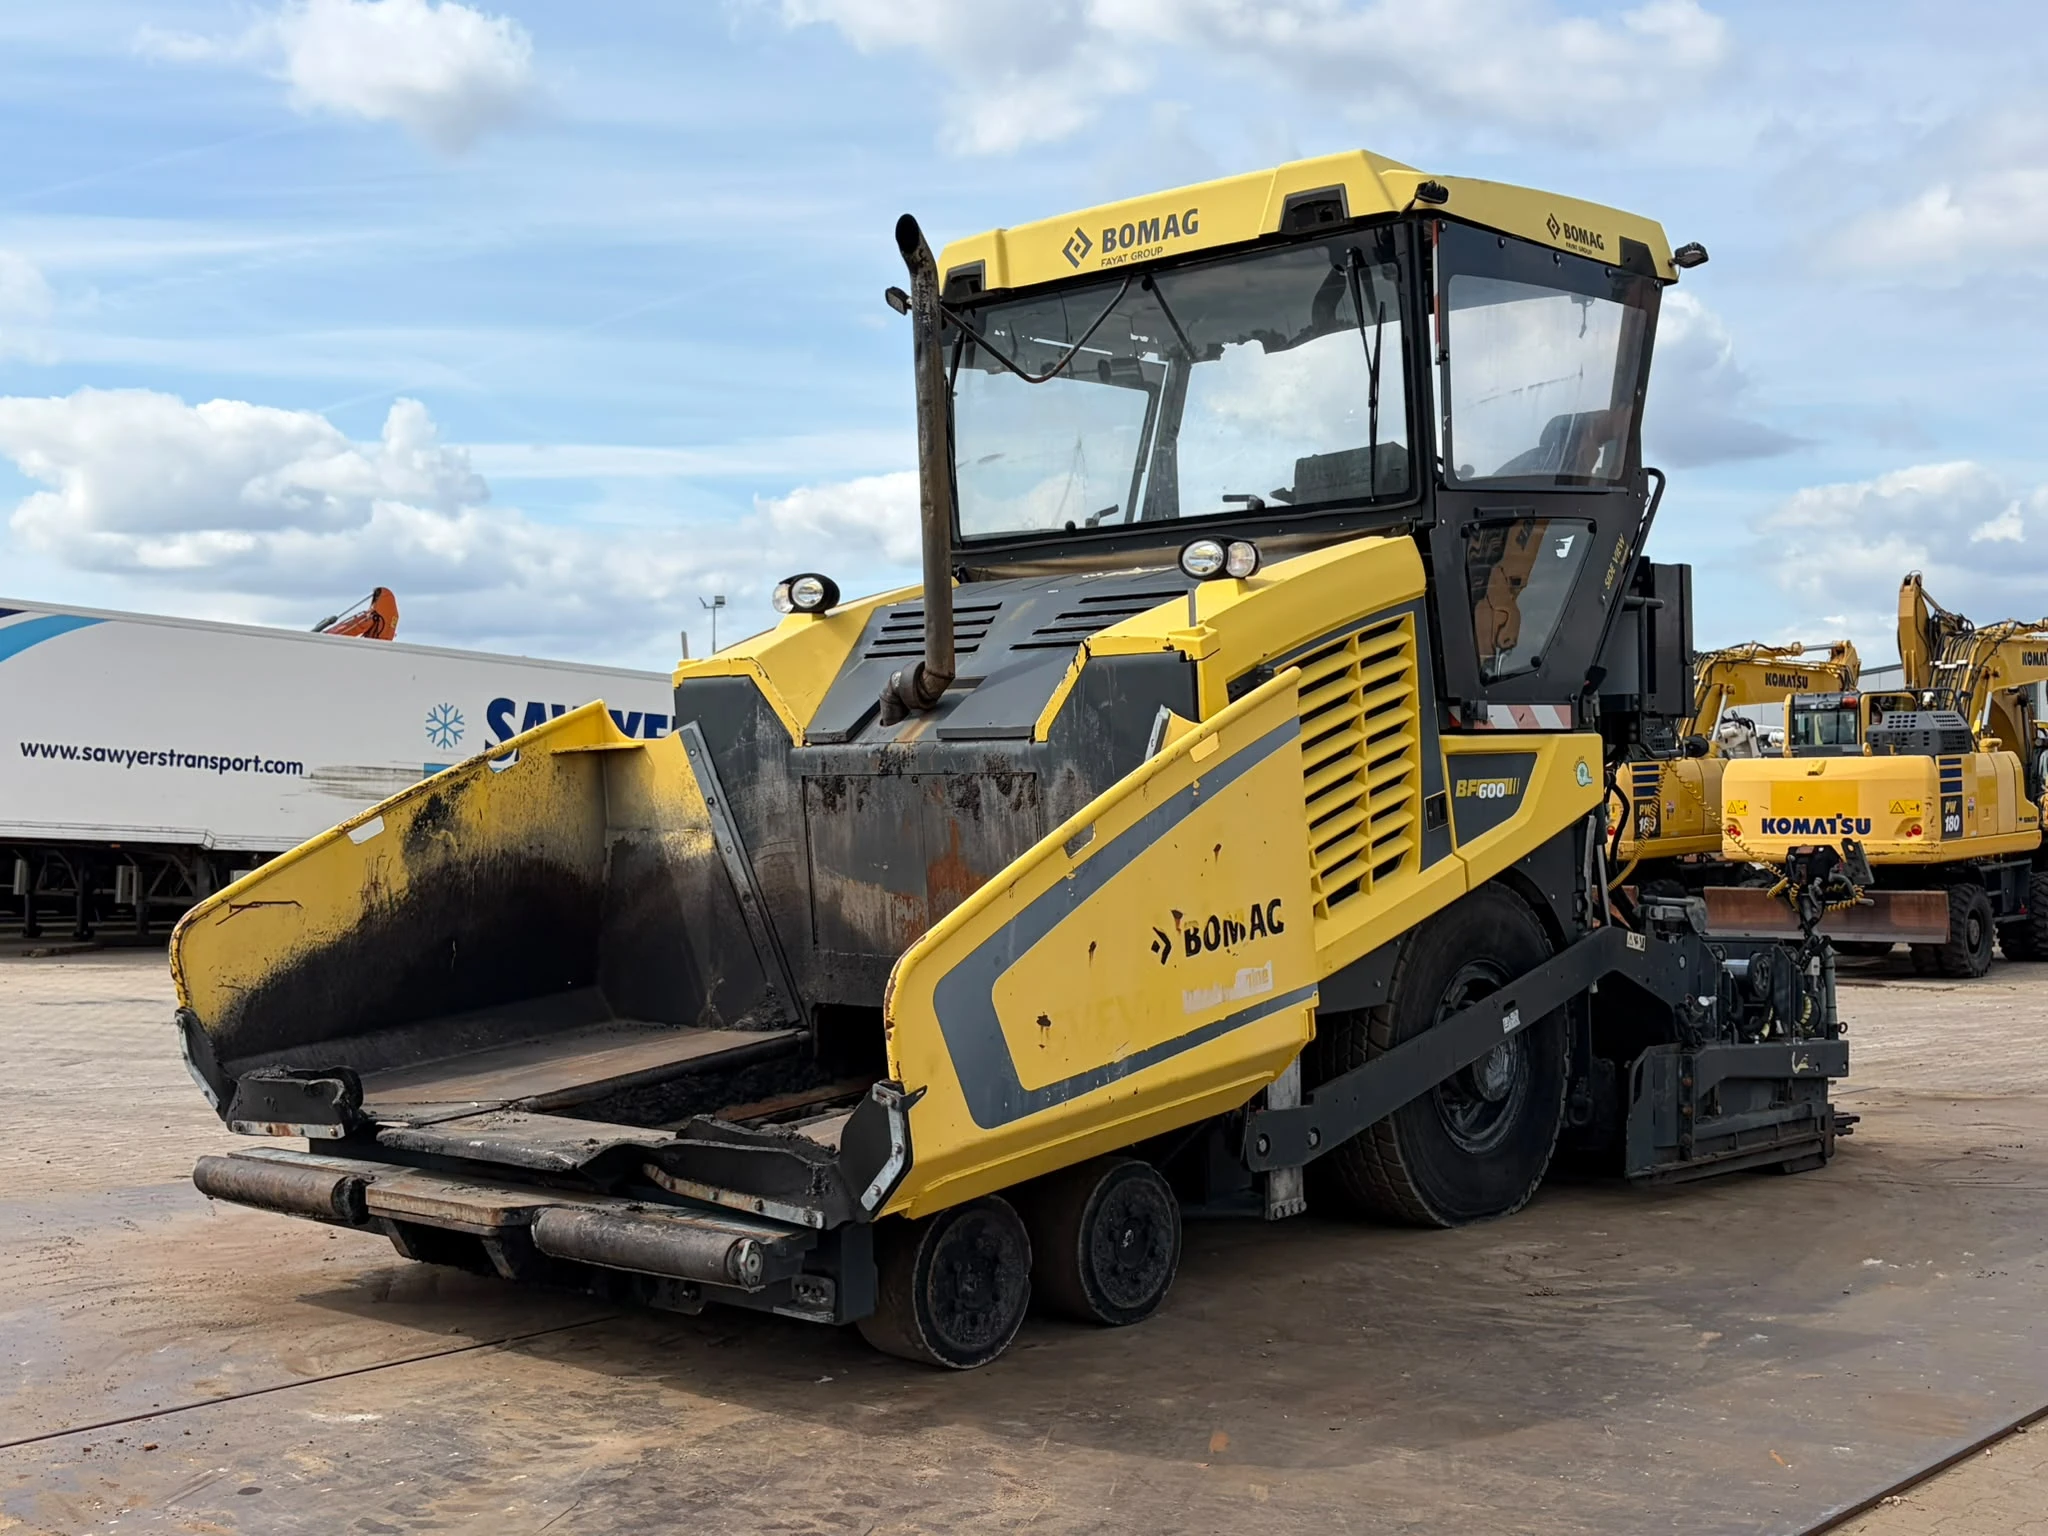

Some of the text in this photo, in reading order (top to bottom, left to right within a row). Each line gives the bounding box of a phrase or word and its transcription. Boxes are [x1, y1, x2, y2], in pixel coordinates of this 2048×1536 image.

[1102, 208, 1199, 254] BOMAG
[1563, 222, 1605, 251] BOMAG
[1101, 246, 1164, 268] FAYAT GROUP
[1765, 671, 1808, 689] KOMATSU
[20, 742, 304, 775] www.sawyerstransport.com
[1945, 800, 1957, 814] PW
[1761, 813, 1871, 835] KOMATSU
[1945, 815, 1960, 833] 180
[1184, 898, 1285, 957] BOMAG
